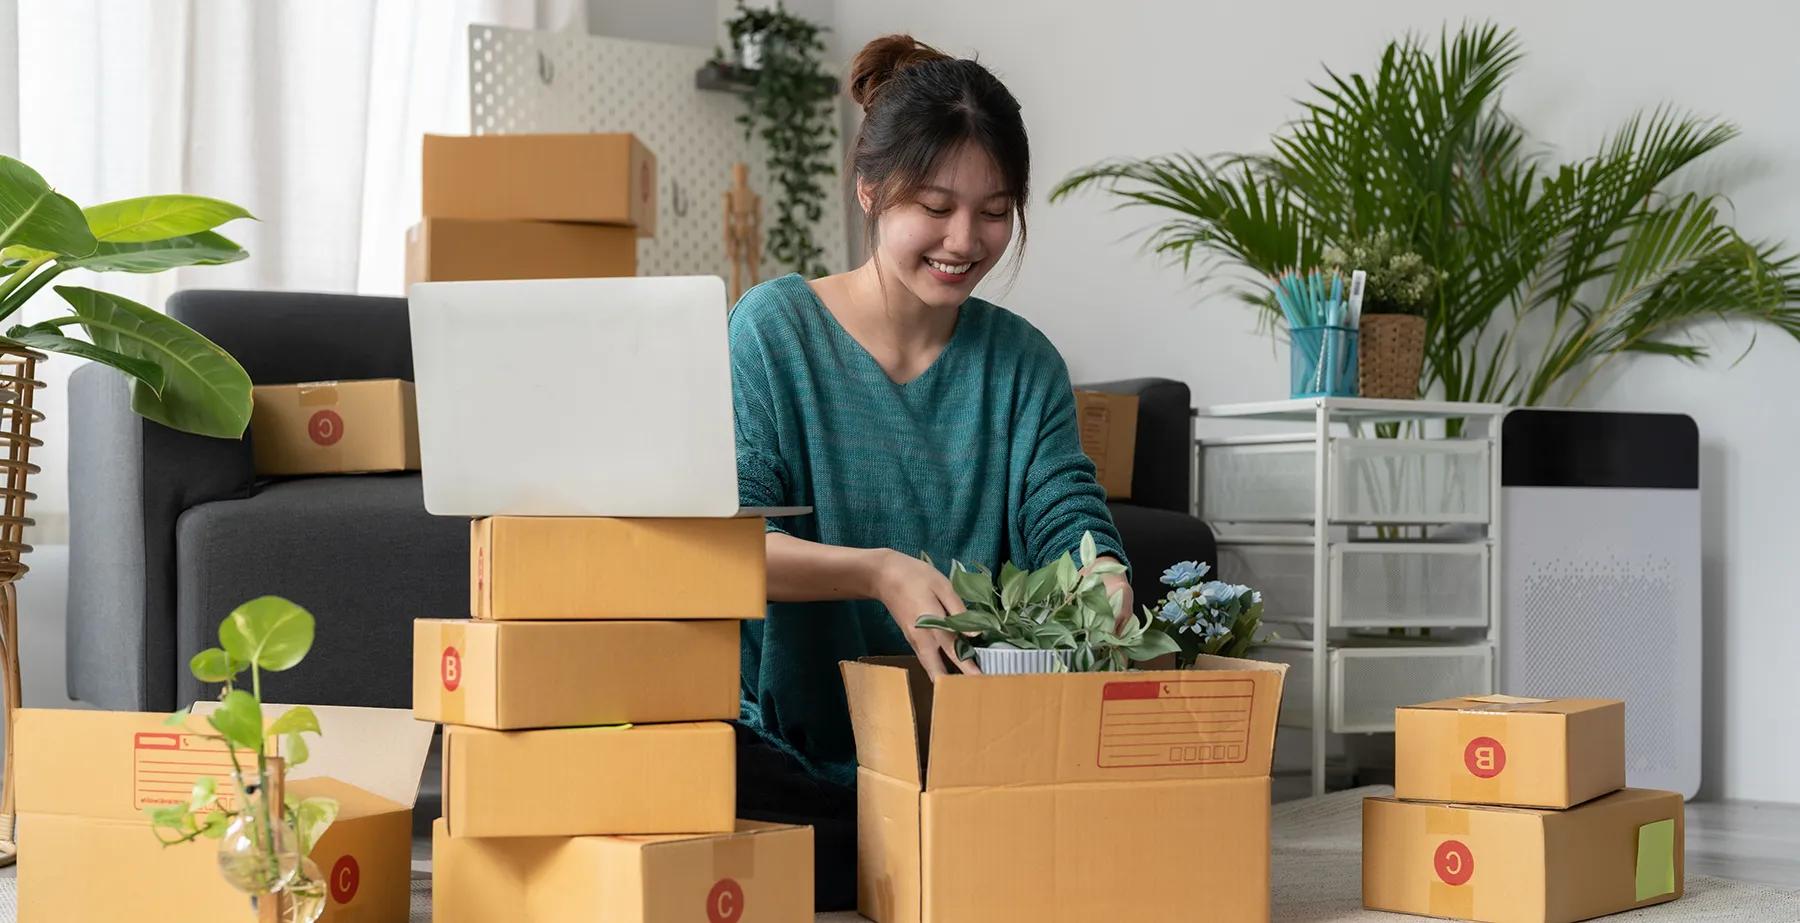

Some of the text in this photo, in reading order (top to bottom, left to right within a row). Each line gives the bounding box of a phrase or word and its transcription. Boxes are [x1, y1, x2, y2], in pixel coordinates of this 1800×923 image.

[446, 656, 457, 681] B
[1475, 747, 1495, 769] B
[1446, 851, 1461, 874] C
[339, 867, 351, 892] C
[717, 891, 732, 918] C
